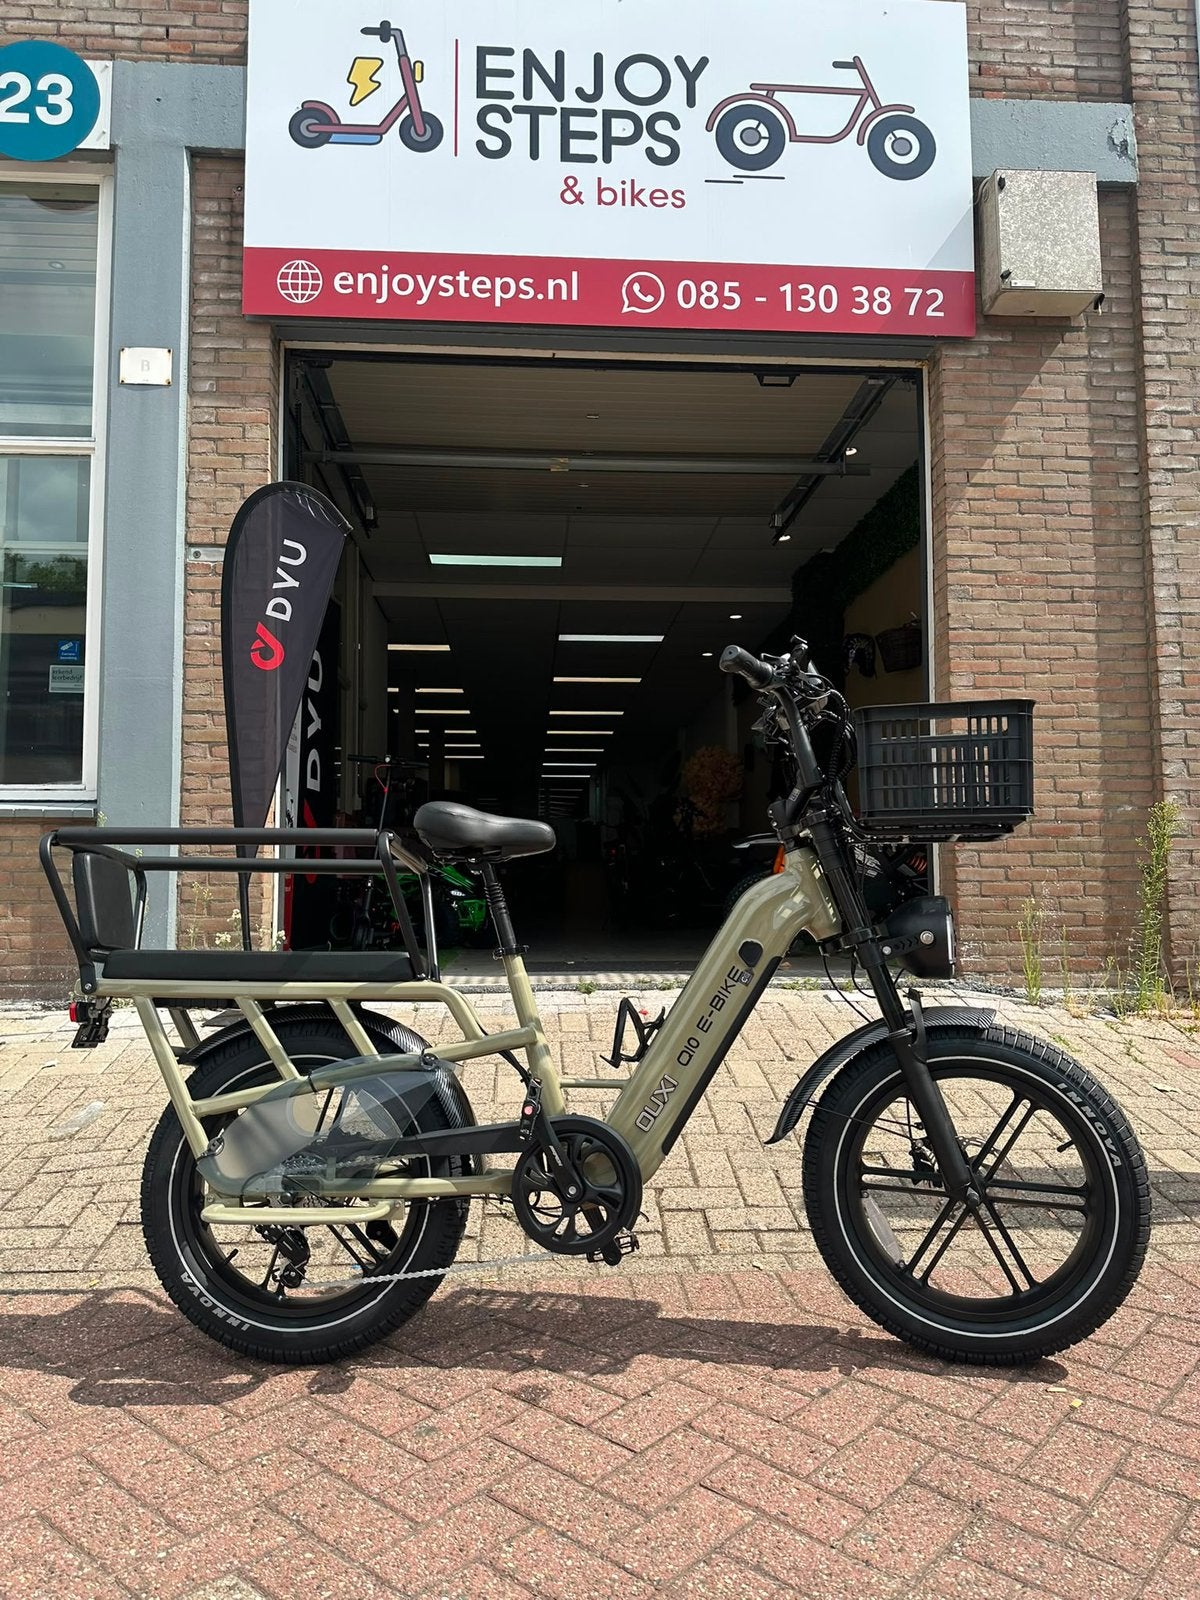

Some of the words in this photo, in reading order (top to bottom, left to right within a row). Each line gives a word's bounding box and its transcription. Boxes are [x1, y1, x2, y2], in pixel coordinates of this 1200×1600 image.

[0, 71, 74, 126] 23
[476, 45, 710, 109] ENJOY
[475, 103, 681, 167] STEPS
[559, 175, 585, 205] &
[597, 176, 686, 209] bikes
[333, 264, 578, 307] enjoysteps.nl
[676, 279, 742, 310] 085
[779, 282, 838, 314] 130
[851, 284, 892, 316] 38
[903, 287, 945, 317] 72
[265, 538, 308, 622] DYU
[635, 1073, 679, 1133] OUXI
[696, 965, 744, 1034] E-BIKE
[1056, 1082, 1122, 1167] INNOVA
[180, 1271, 251, 1332] INNOVA
